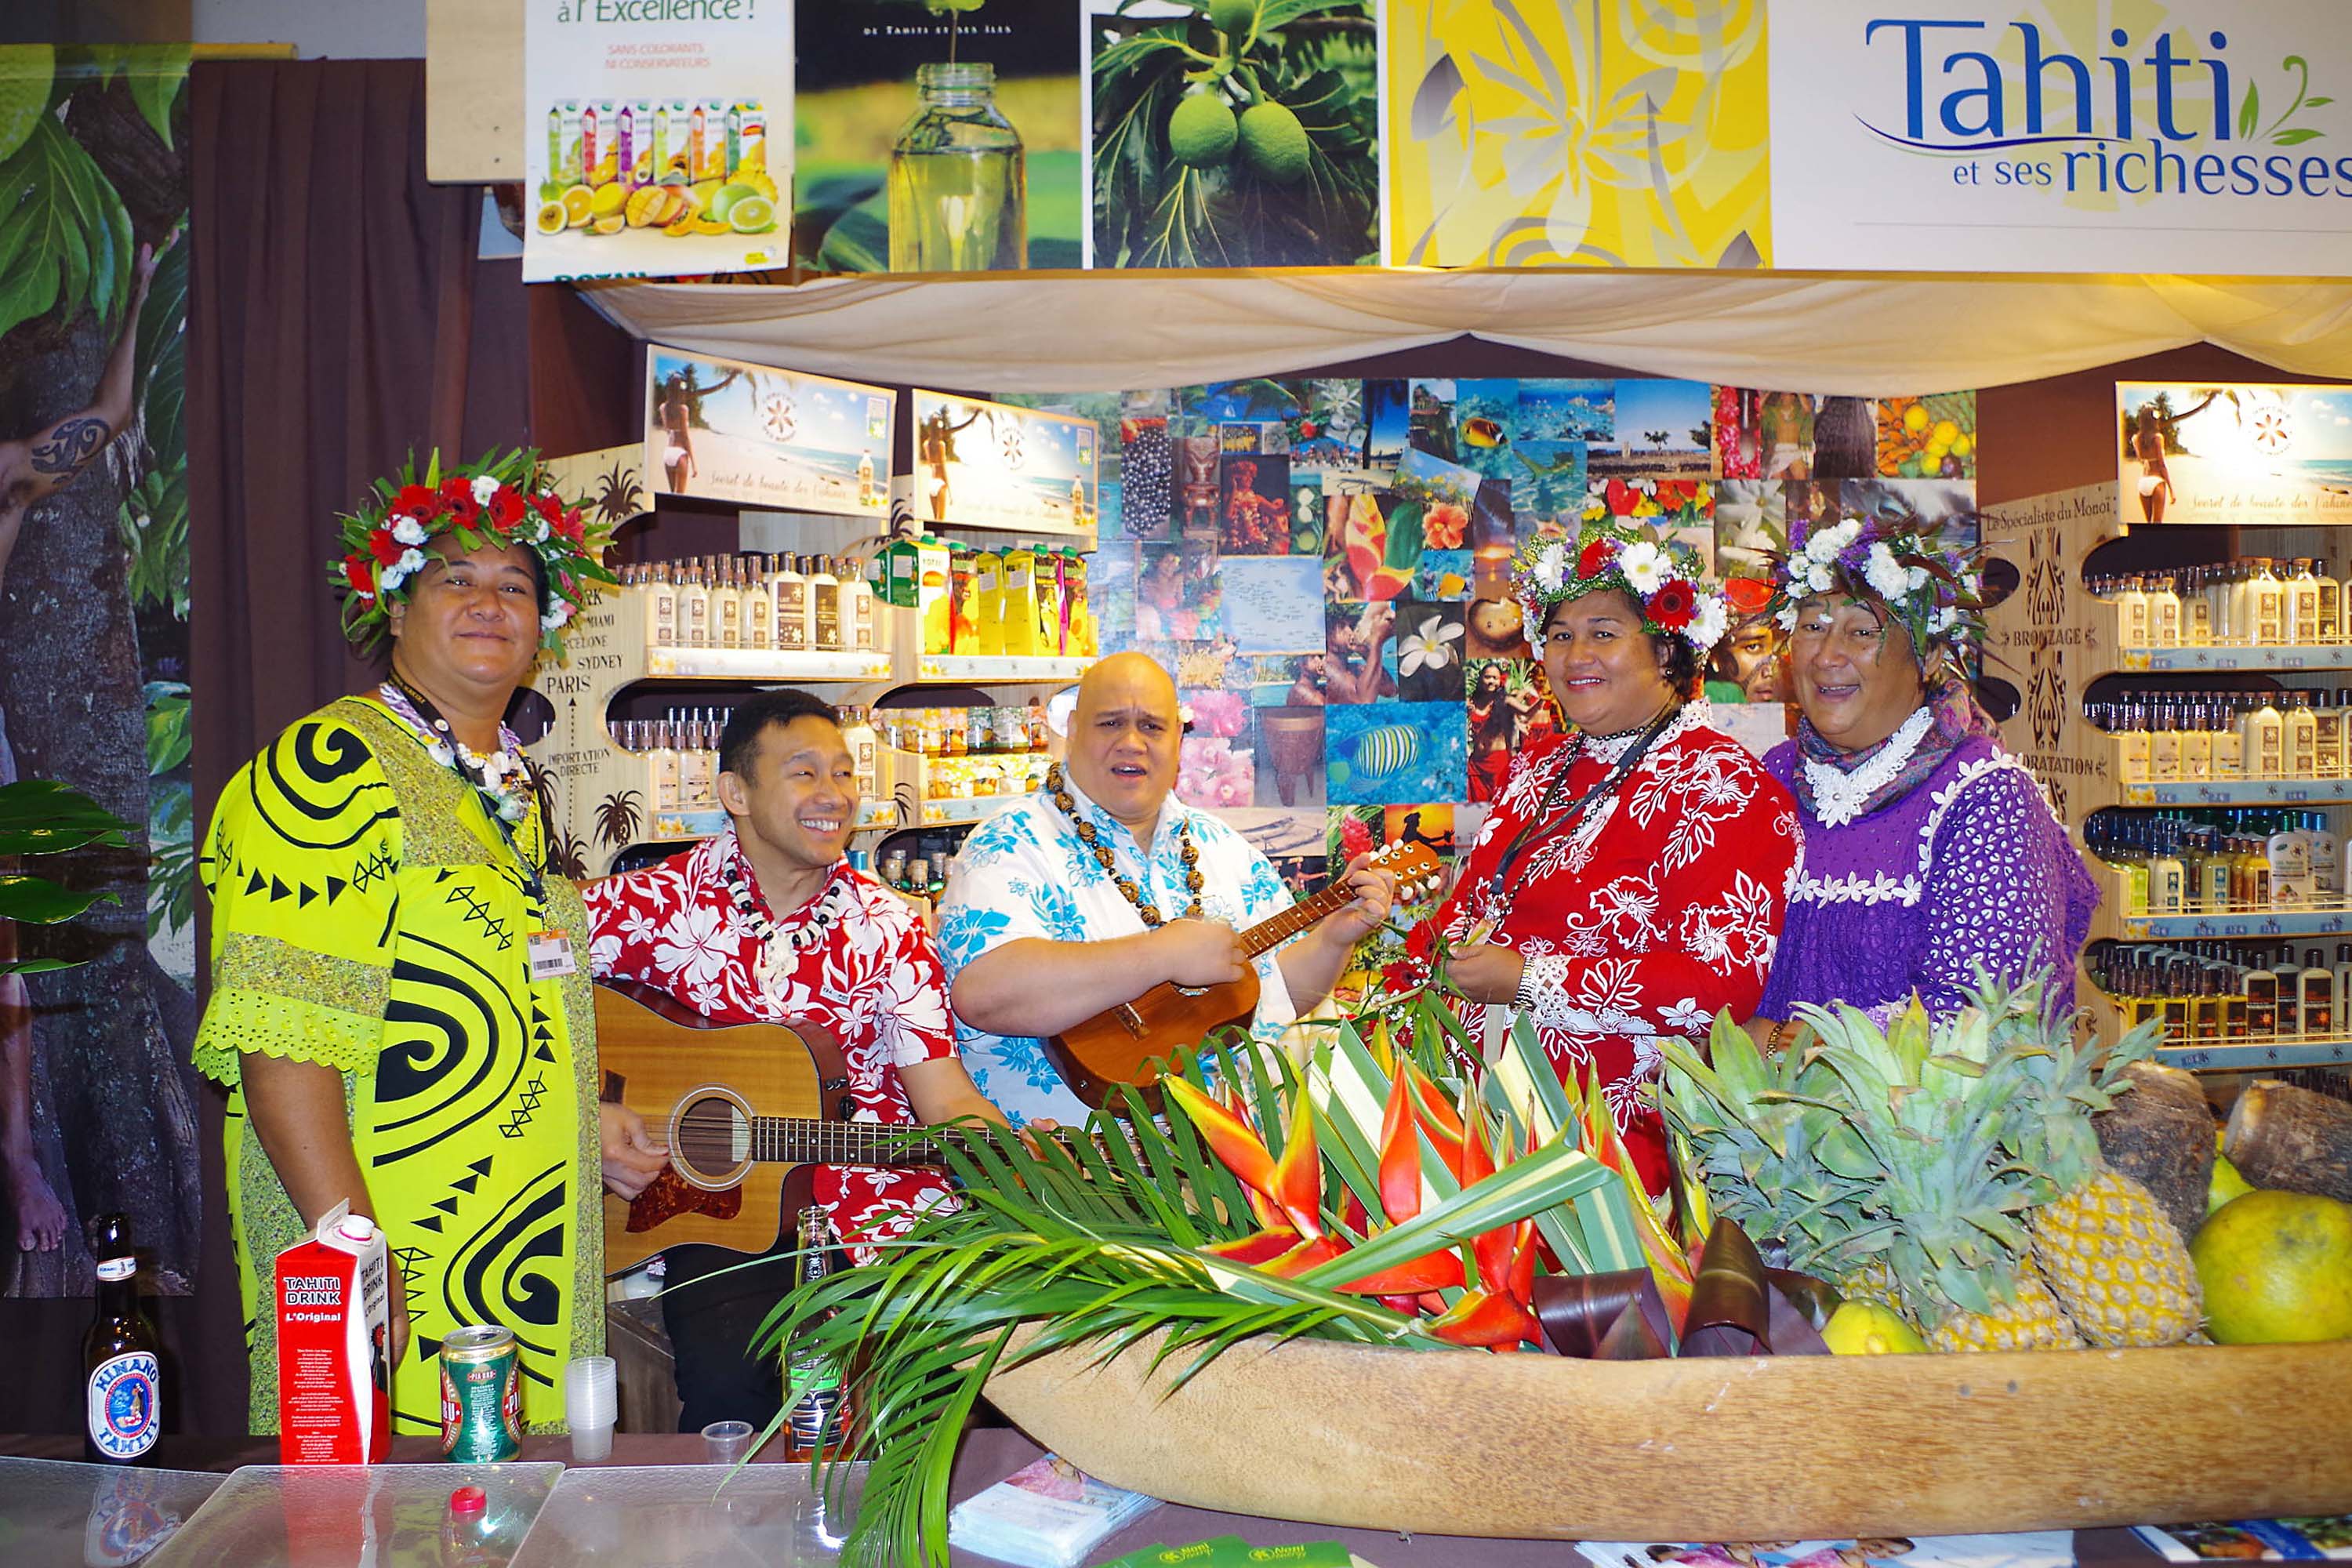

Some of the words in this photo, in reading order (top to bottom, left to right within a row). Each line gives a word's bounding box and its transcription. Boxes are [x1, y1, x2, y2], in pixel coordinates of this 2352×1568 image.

[1865, 17, 2232, 141] Tahiti
[1952, 158, 1980, 186] et
[1994, 160, 2053, 187] ses
[2061, 136, 2352, 198] richesses
[2057, 500, 2071, 521] du
[586, 613, 615, 628] MIAMI
[563, 634, 608, 650] RCELONE
[2013, 627, 2082, 647] BRONZAGE
[577, 654, 624, 671] SYDNEY
[547, 674, 591, 695] PARIS
[548, 747, 611, 767] IMPORTATION
[2023, 754, 2093, 775] DRATATION
[559, 761, 600, 777] DIRECTE
[283, 1277, 340, 1290] TAHITI
[285, 1291, 341, 1305] DRINK
[285, 1312, 341, 1323] L'Original
[95, 1359, 158, 1393] HINANO
[98, 1421, 158, 1453] TAHITI
[1181, 1542, 1210, 1555] Noni
[1275, 1544, 1305, 1554] Noni
